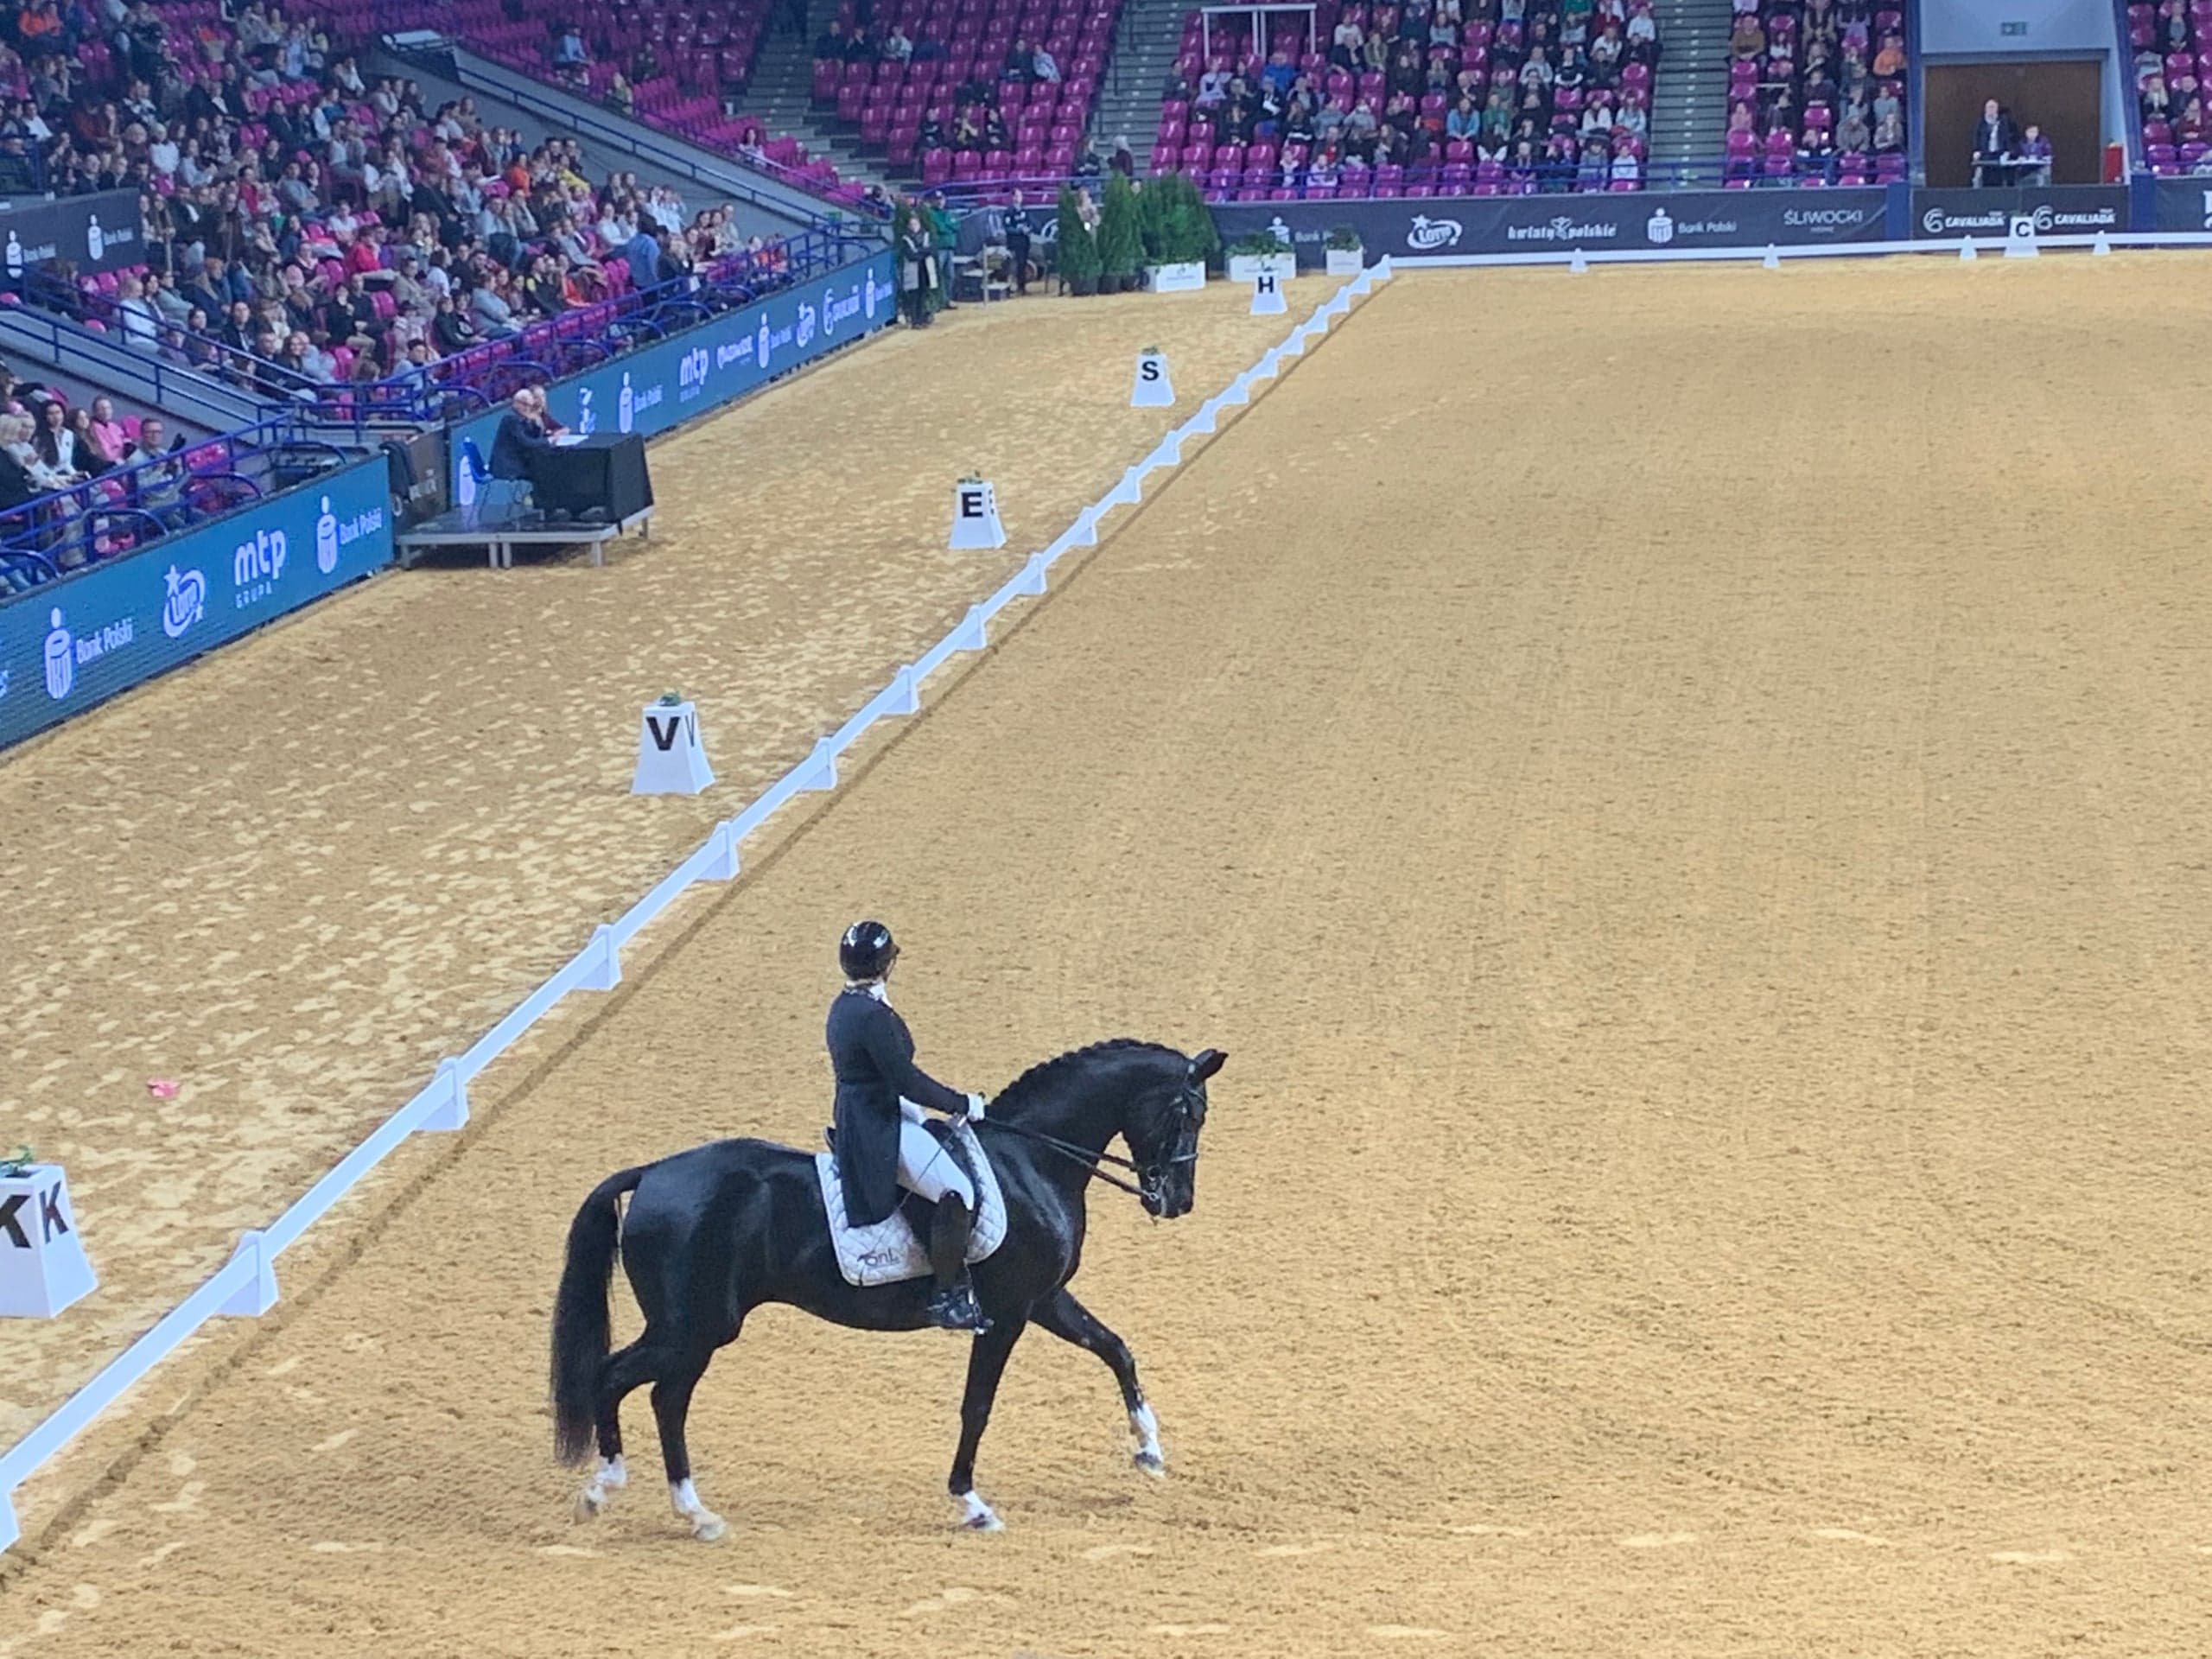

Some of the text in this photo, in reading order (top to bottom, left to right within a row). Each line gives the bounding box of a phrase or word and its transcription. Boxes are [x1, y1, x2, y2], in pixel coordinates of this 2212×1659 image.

[1678, 221, 1705, 234] Bank
[1945, 216, 2004, 227] CAVALIADA
[2015, 221, 2031, 238] C
[2055, 213, 2115, 225] CAVALIADA
[1258, 276, 1274, 294] H
[679, 347, 709, 387] mtp
[1141, 360, 1160, 381] S
[961, 492, 983, 518] E
[234, 529, 287, 587] mtp
[76, 617, 133, 664] Bank Polski
[645, 715, 681, 751] V
[39, 1179, 69, 1244] K
